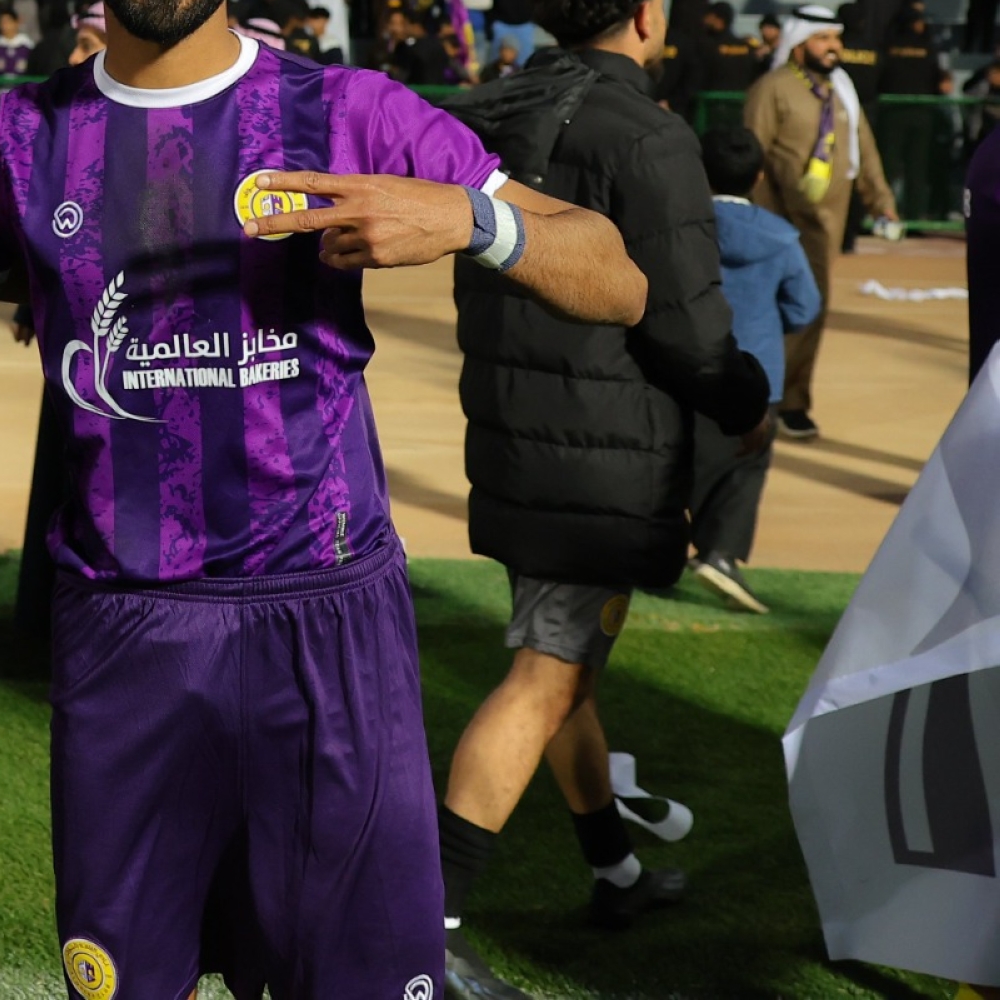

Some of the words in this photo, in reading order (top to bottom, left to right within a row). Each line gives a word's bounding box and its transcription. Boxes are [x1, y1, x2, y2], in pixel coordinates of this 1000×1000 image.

[125, 332, 230, 367] العالمية
[237, 328, 298, 366] مخابز
[122, 368, 236, 390] INTERNATIONAL
[239, 358, 300, 388] BAKERIES
